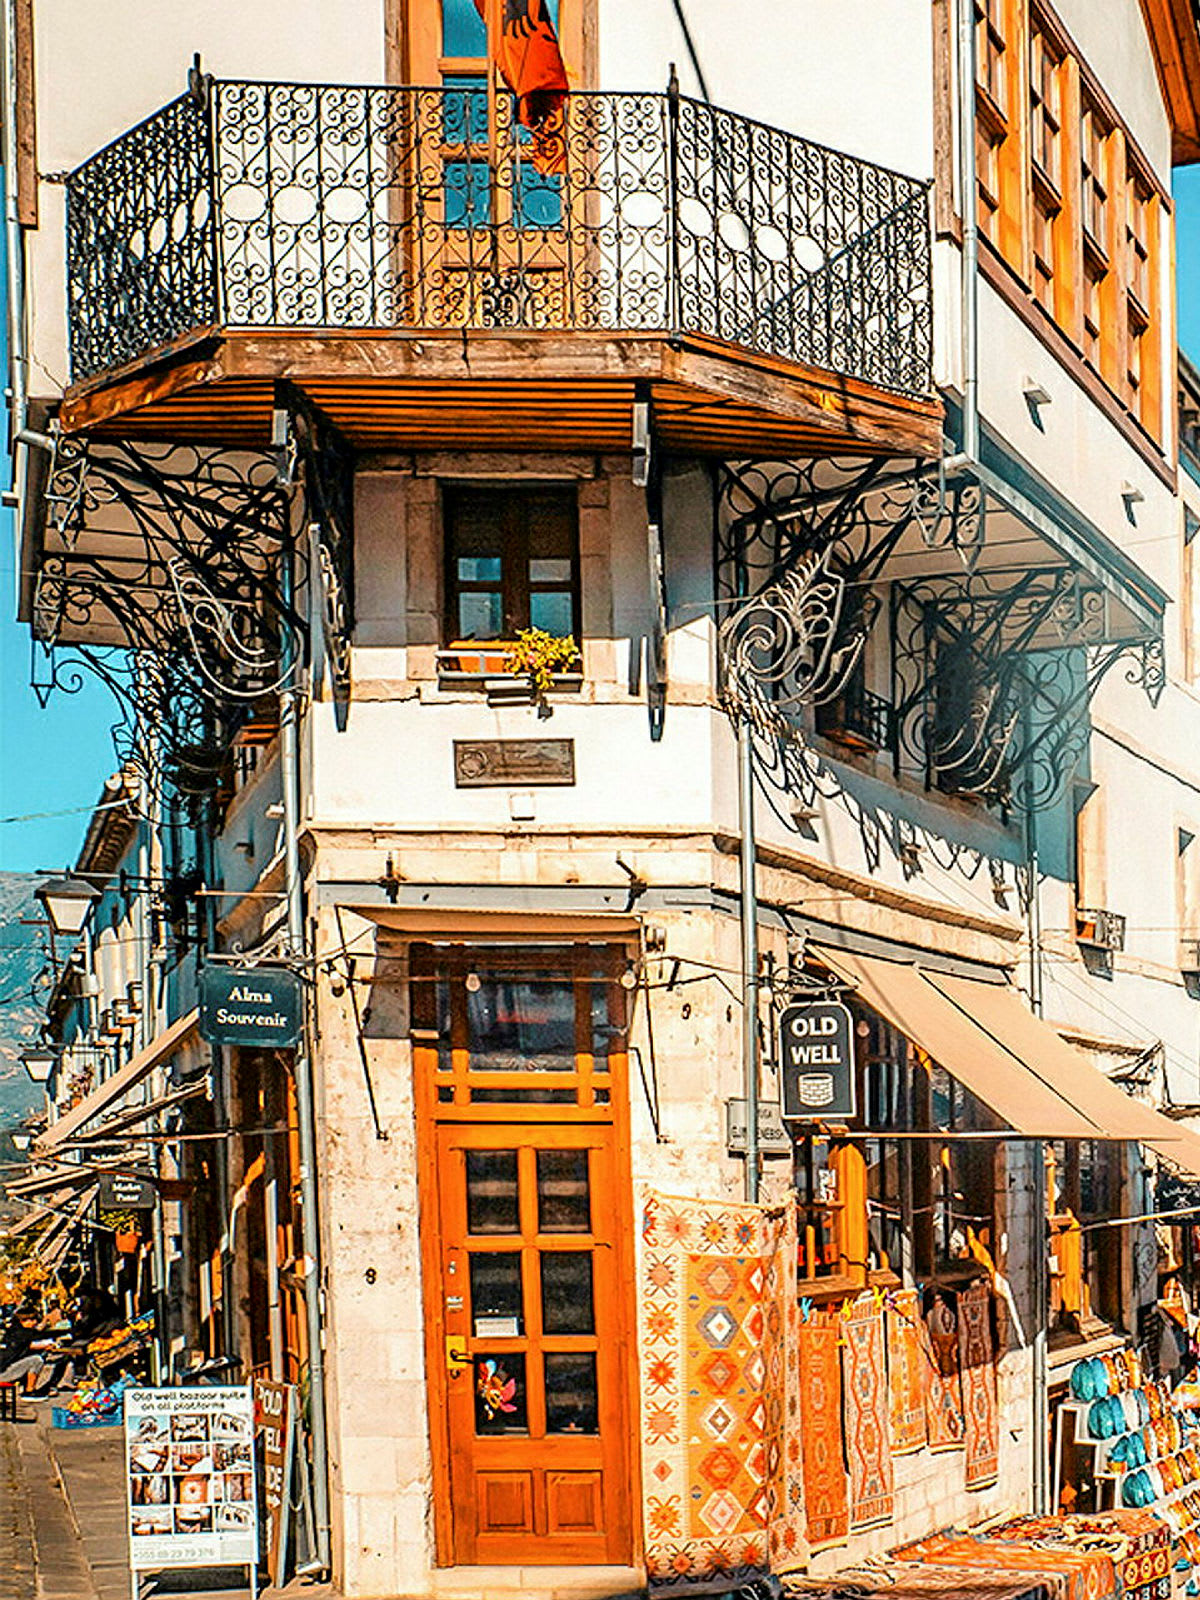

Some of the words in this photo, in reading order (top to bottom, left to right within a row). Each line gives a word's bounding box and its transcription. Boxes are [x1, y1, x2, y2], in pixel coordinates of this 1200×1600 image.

[228, 986, 273, 1004] Alma
[216, 1008, 288, 1028] Souvenir
[791, 1016, 838, 1037] OLD
[791, 1045, 842, 1065] WELL
[131, 1391, 152, 1402] Old
[155, 1391, 177, 1401] well
[179, 1390, 216, 1401] bazaar
[219, 1390, 246, 1401] suite
[157, 1401, 171, 1410] all
[173, 1400, 225, 1411] platforms
